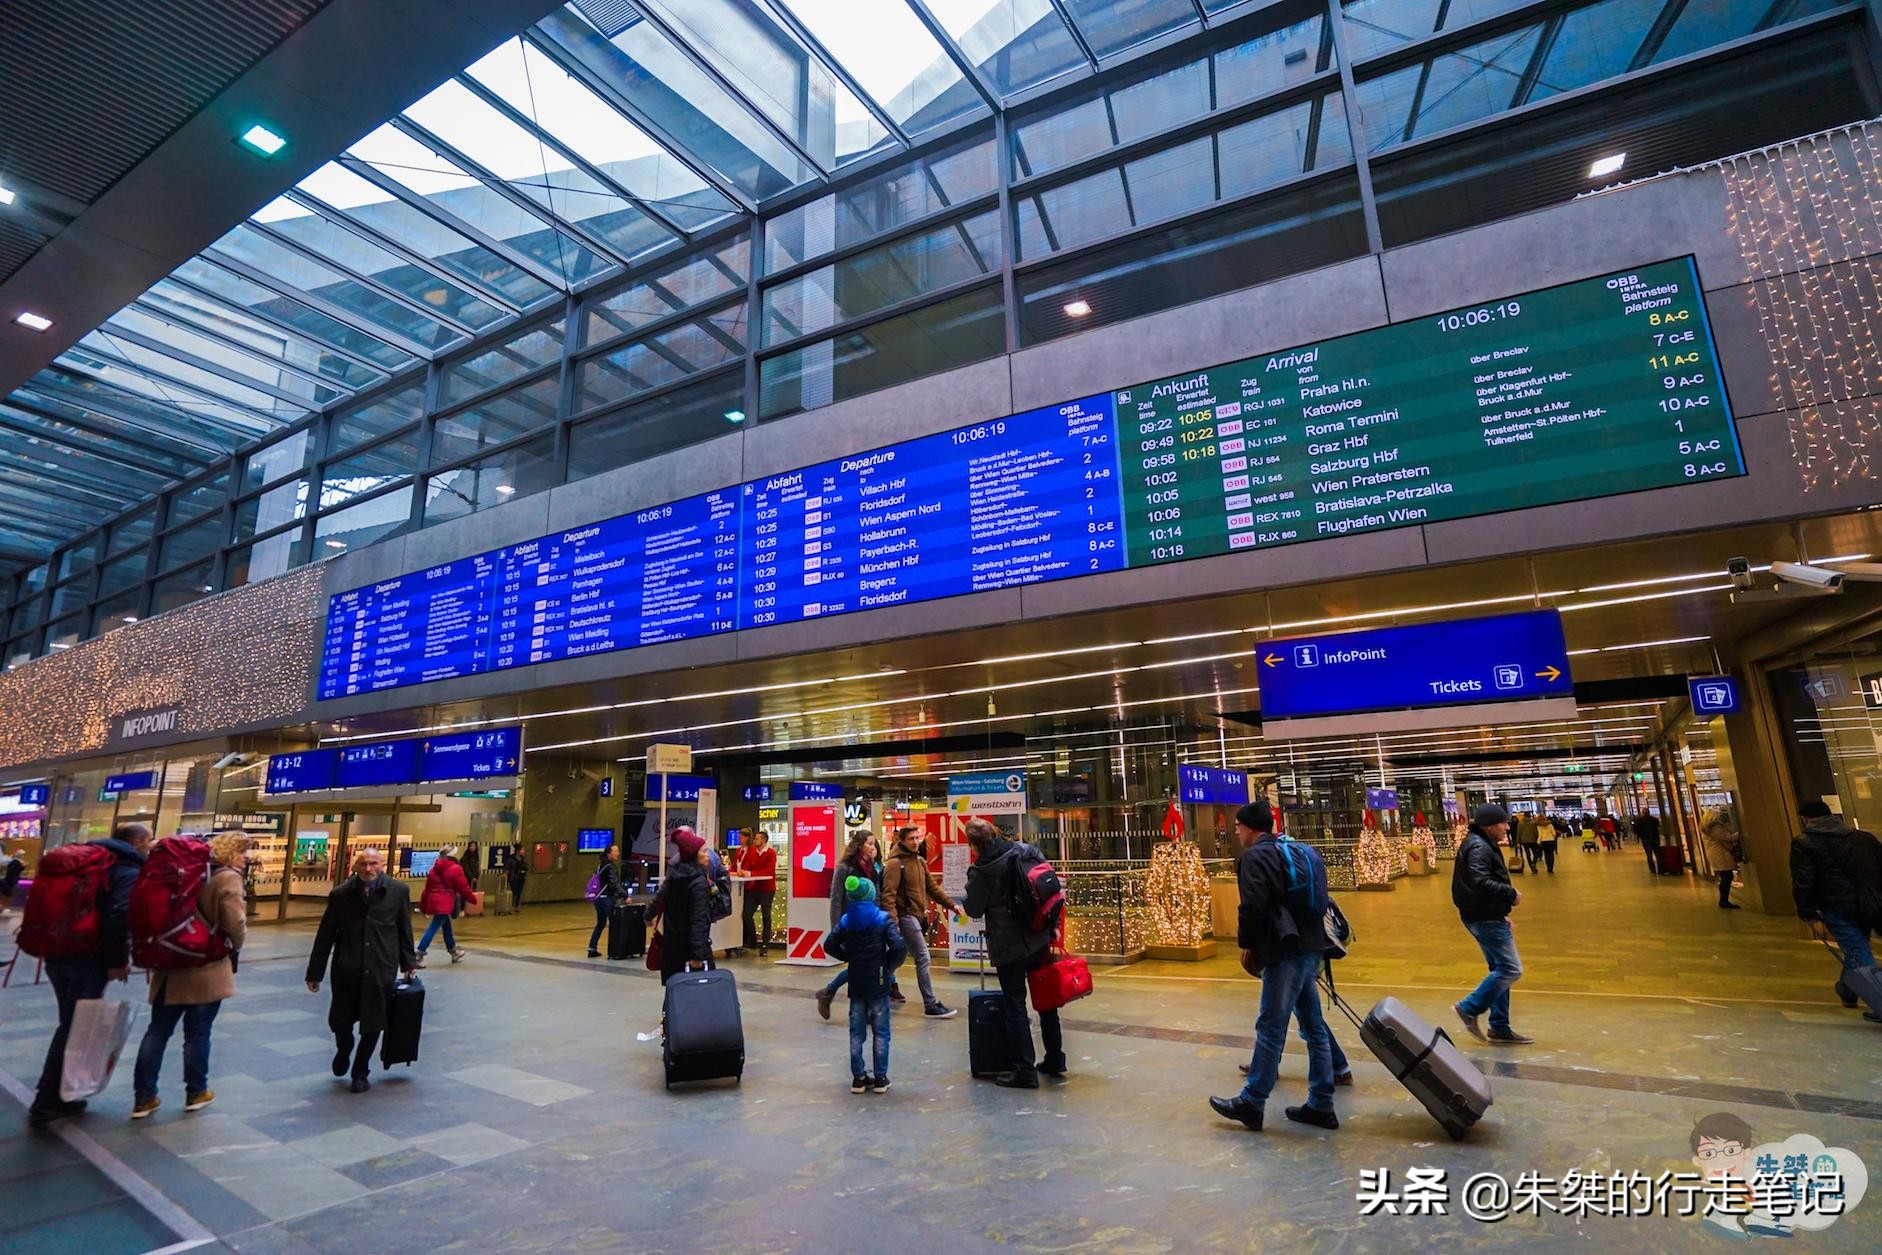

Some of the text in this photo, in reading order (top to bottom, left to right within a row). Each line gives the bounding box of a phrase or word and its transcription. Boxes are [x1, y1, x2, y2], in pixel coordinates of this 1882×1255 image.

[1622, 284, 1678, 302] Bahnsteig
[1625, 297, 1671, 315] platform
[1437, 302, 1521, 332] 10:06:19
[1649, 310, 1689, 326] 8 A-C
[1653, 330, 1695, 347] 7 C-E
[1265, 348, 1319, 372] Arrival
[1470, 346, 1529, 364] über Breclav
[1649, 352, 1700, 370] 11 A-C
[1297, 365, 1313, 375] von
[1474, 366, 1533, 384] über Breclav
[1152, 374, 1209, 398] Ankunft
[1240, 378, 1257, 388] Zug
[1298, 374, 1319, 385] from
[1476, 375, 1547, 397] über Klagenfurt
[1663, 373, 1704, 389] 9 A-C
[1176, 388, 1209, 402] Erwartet
[1242, 386, 1261, 397] train
[1301, 377, 1371, 400] Praha hl.n.
[1478, 387, 1543, 407] Bruck a.d.Mur
[1138, 401, 1153, 411] Zeit
[1177, 396, 1217, 412] estimated
[1303, 398, 1362, 418] Katowice
[1481, 400, 1571, 424] über Bruck a.d.Mur
[1659, 395, 1710, 412] 10 A-C
[1068, 412, 1104, 426] Bahnsteig
[1139, 410, 1156, 420] time
[1140, 418, 1172, 434] 09:22
[1179, 409, 1212, 426] 10:05
[1243, 402, 1265, 412] RGJ
[1305, 408, 1399, 437] Roma Termini
[951, 422, 1006, 445] 10:06:19
[1068, 423, 1099, 437] platform
[1141, 418, 1277, 451] 09:49 10:22 EC 101
[1674, 420, 1684, 433] 1
[1083, 435, 1108, 446] 7 A-C
[1308, 434, 1369, 456] Graz Hbf
[1484, 431, 1534, 447] Tullnerfeld
[1679, 439, 1720, 455] 5 A-C
[840, 451, 895, 472] Departure
[1083, 453, 1092, 463] 2
[1143, 453, 1175, 469] 09:58
[1182, 445, 1216, 461] 10:18
[1248, 439, 1261, 449] NJ
[1310, 448, 1399, 475] Salzburg Hbf
[1085, 469, 1110, 480] 4 A-B
[1144, 457, 1264, 487] 10:02 RJ
[1684, 462, 1726, 477] 8 A-C
[766, 473, 802, 491] Abfahrt
[859, 478, 906, 496] Villach Hbf
[1312, 465, 1430, 495] Wien Praterstern
[1085, 488, 1094, 498] 2
[1146, 475, 1265, 505] 10:05 RJ
[1315, 482, 1453, 514] Bratislava-Petrzalka
[860, 493, 906, 512] Floridsdorf
[1087, 505, 1094, 515] 1
[1147, 507, 1181, 523] 10:06
[1254, 493, 1277, 505] west
[636, 507, 672, 524] 10:06:19
[756, 508, 778, 520] 10:25
[860, 501, 941, 527] Wien Aspern Nord
[1317, 507, 1428, 534] Flughafen Wien
[719, 521, 724, 530] 2
[756, 522, 777, 535] 10:25
[1087, 522, 1114, 533] 8 C-E
[1149, 512, 1279, 541] 10:14 REX
[715, 535, 723, 544] 12
[860, 527, 906, 543] Hollabrunn
[714, 549, 722, 558] 12
[860, 539, 919, 558] Payerbach-R.
[1089, 540, 1115, 551] 8 A-C
[1151, 532, 1280, 560] 10:18 RJX
[755, 552, 776, 564] 10:27
[860, 554, 919, 575] München Hbf
[1090, 559, 1099, 569] 2
[754, 567, 776, 579] 10:29
[754, 582, 776, 594] 10:30
[860, 577, 896, 590] Bregenz
[753, 597, 775, 609] 10:30
[860, 589, 907, 607] Floridsdorf
[753, 612, 775, 624] 10:30
[1324, 647, 1387, 664] InfoPoint
[1430, 678, 1482, 695] Tickets
[122, 709, 178, 738] INFOPOINT
[602, 781, 609, 794] 3
[744, 788, 752, 799] 4
[971, 801, 1022, 809] westbahn
